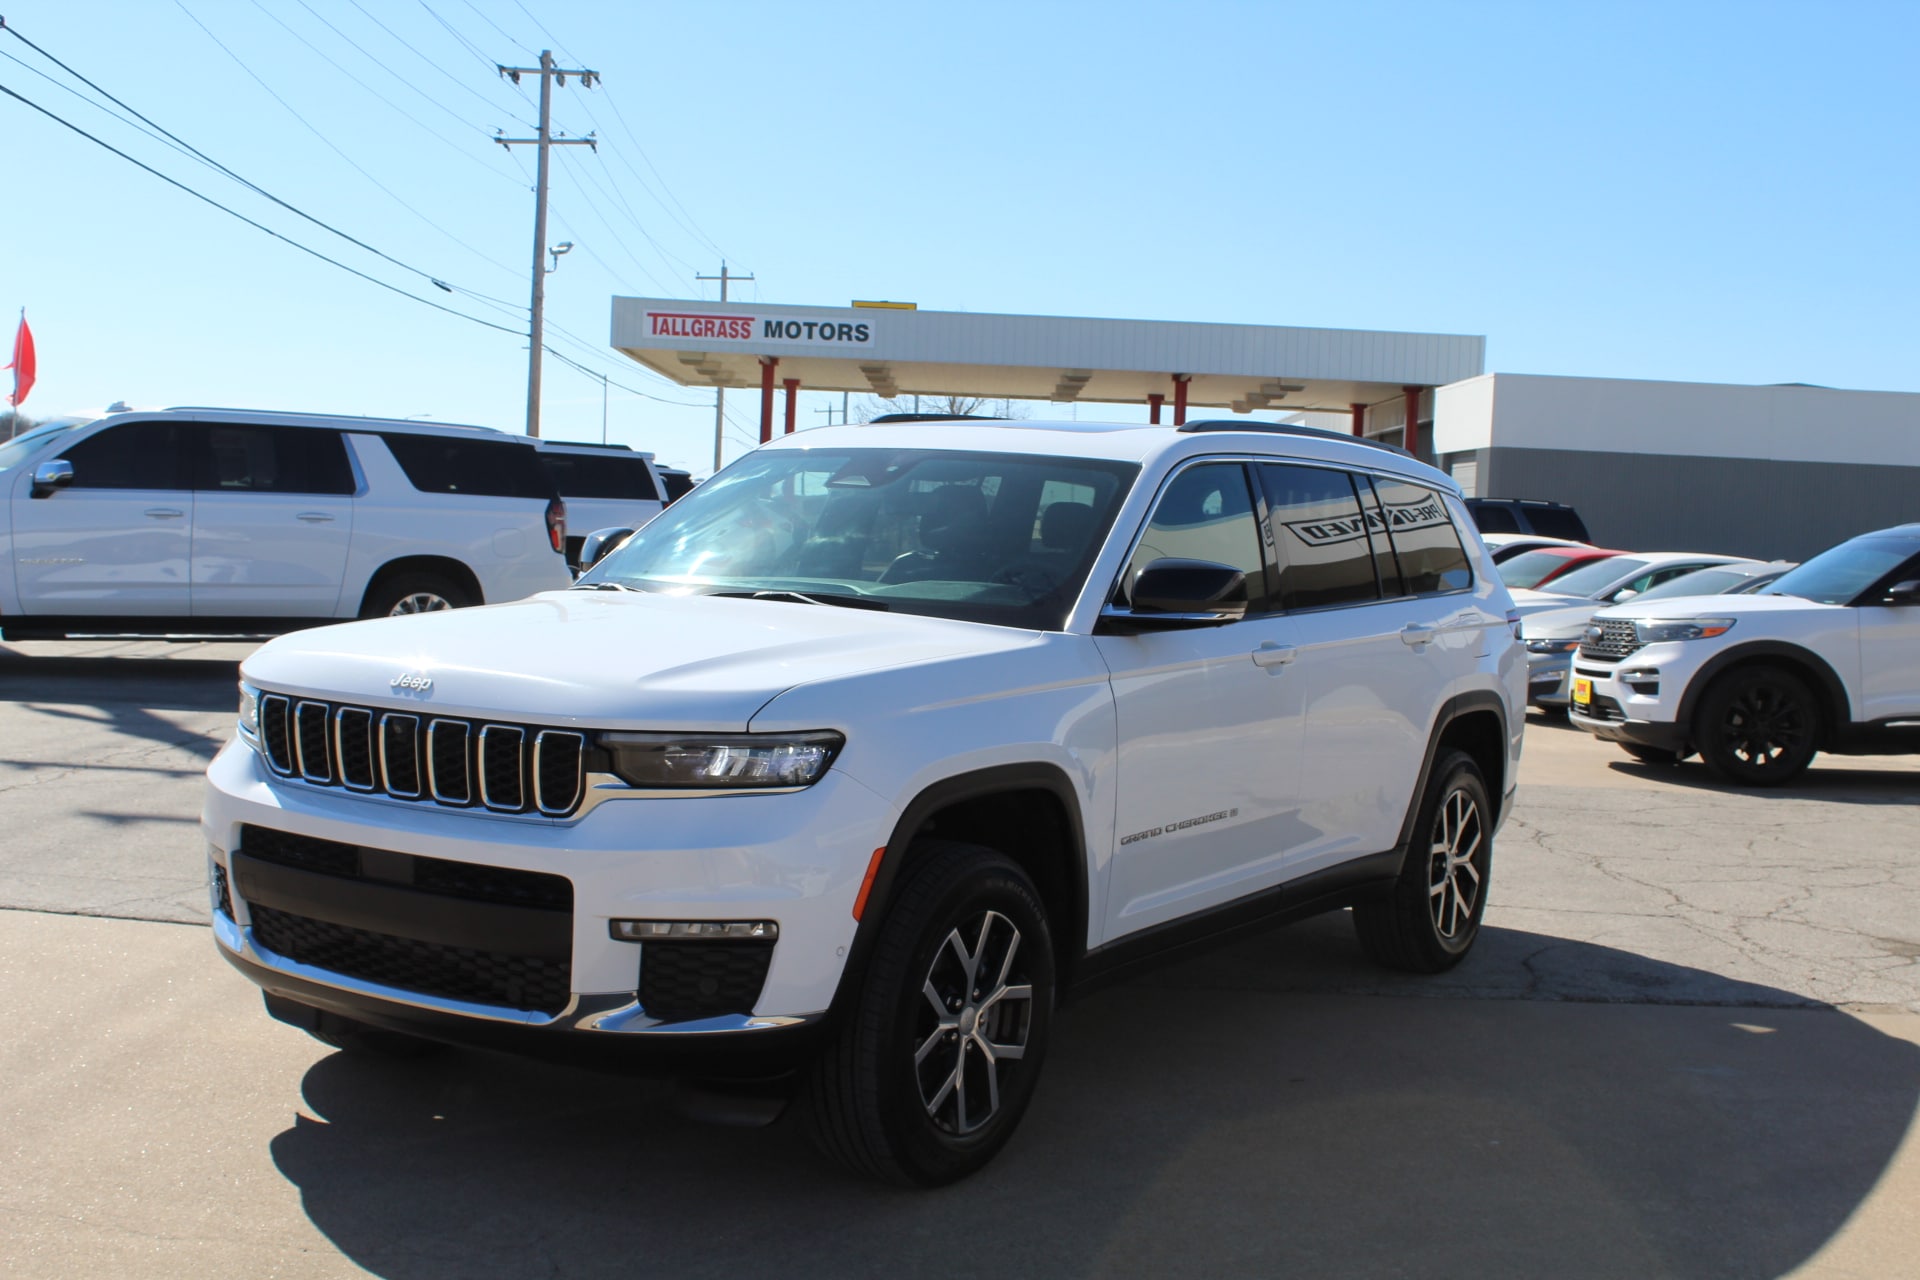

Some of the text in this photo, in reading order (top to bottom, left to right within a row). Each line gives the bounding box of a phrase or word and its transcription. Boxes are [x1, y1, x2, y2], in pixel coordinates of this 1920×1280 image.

[647, 312, 870, 342] TALLGRASS MOTORS
[390, 672, 432, 692] Jeep
[1120, 826, 1162, 846] GRAND
[1165, 810, 1228, 833] CHEROKEE
